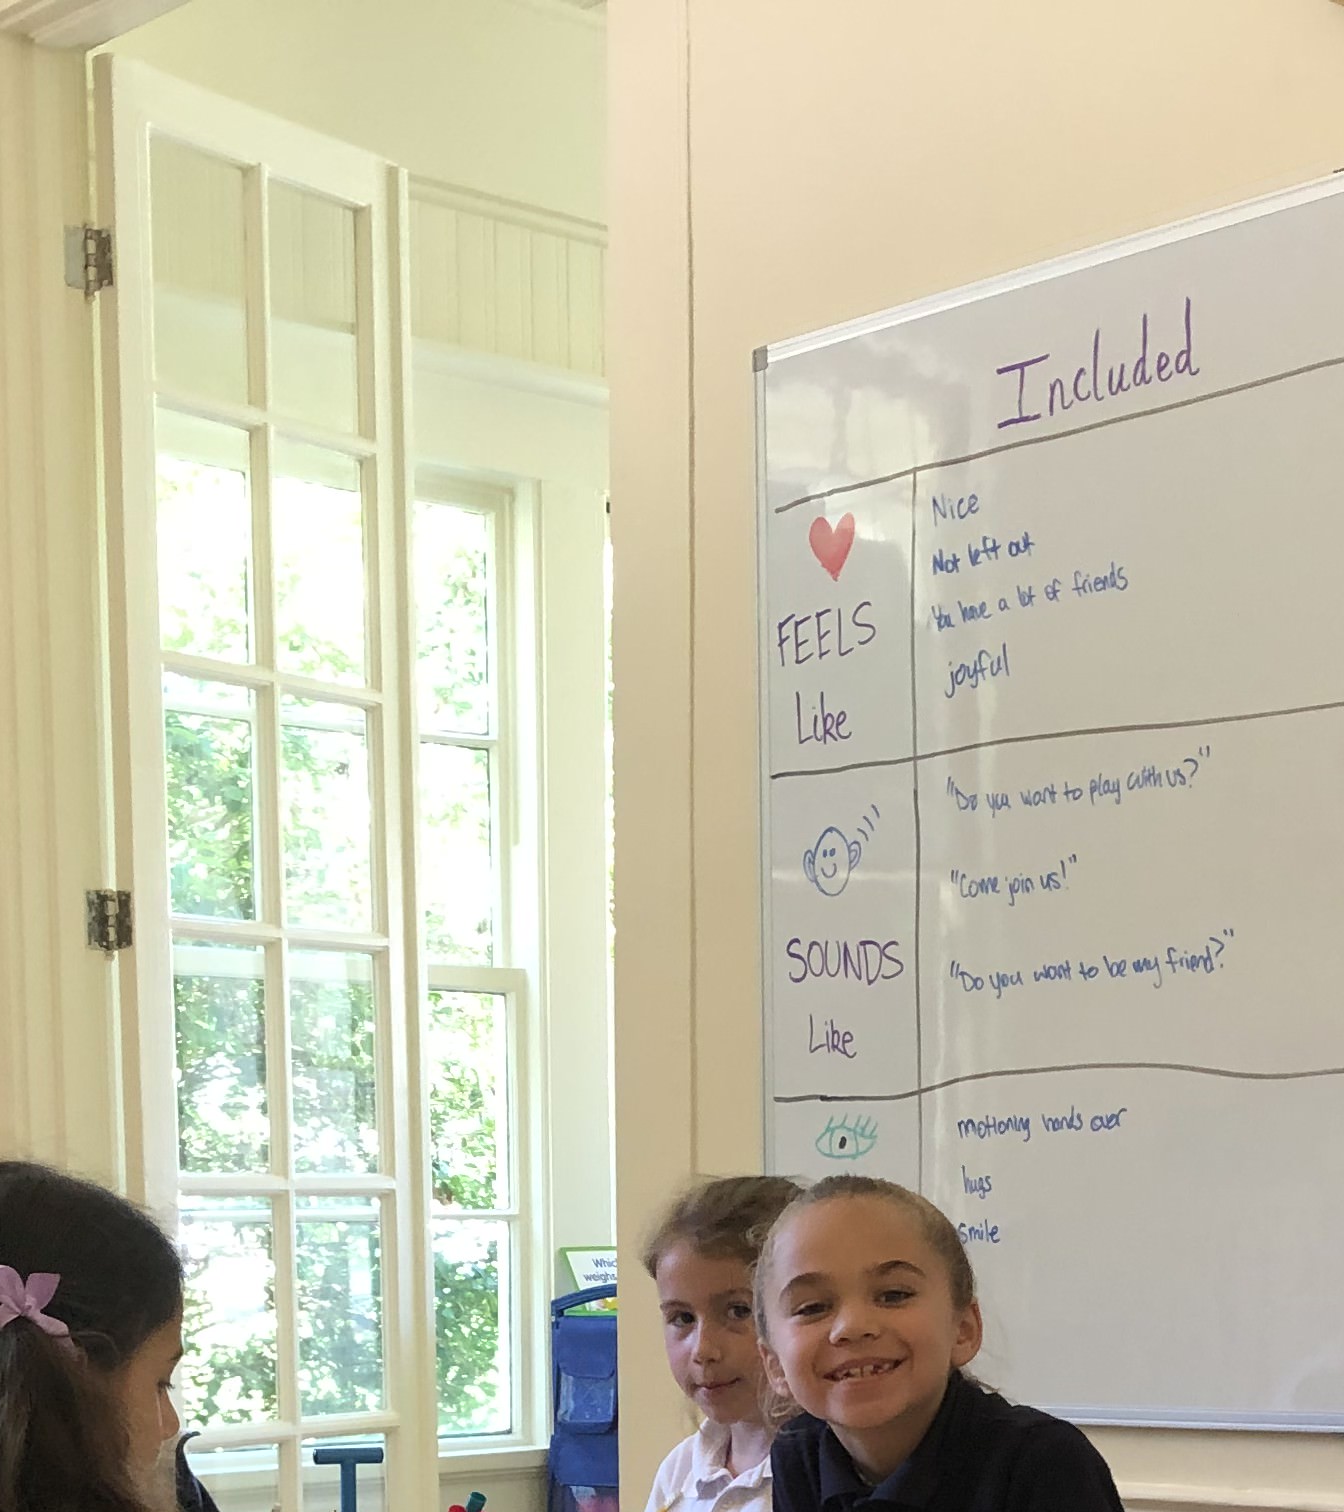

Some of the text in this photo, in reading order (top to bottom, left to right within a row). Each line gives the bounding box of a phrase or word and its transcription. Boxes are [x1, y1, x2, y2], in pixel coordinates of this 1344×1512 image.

[997, 297, 1200, 429] Included
[932, 494, 980, 526] Nice
[932, 532, 1035, 576] Not left out
[931, 561, 1129, 632] You have a lot of friends
[777, 602, 877, 667] FEELS
[944, 643, 1010, 699] joyful
[796, 692, 852, 742] Like
[986, 788, 1011, 818] you
[1020, 781, 1057, 808] want
[1063, 781, 1084, 803] to
[1089, 772, 1122, 806] play
[1127, 763, 1162, 791] with
[1005, 873, 1036, 907] join
[787, 938, 904, 987] SOUNDS
[984, 971, 1024, 1000] you
[1033, 958, 1072, 984] want
[1079, 959, 1098, 980] to
[1102, 953, 1127, 979] be
[1132, 957, 1162, 989] my
[809, 1014, 857, 1060] Like
[1042, 1106, 1084, 1133] hands
[1090, 1107, 1128, 1132] over
[961, 1164, 992, 1199] hugs
